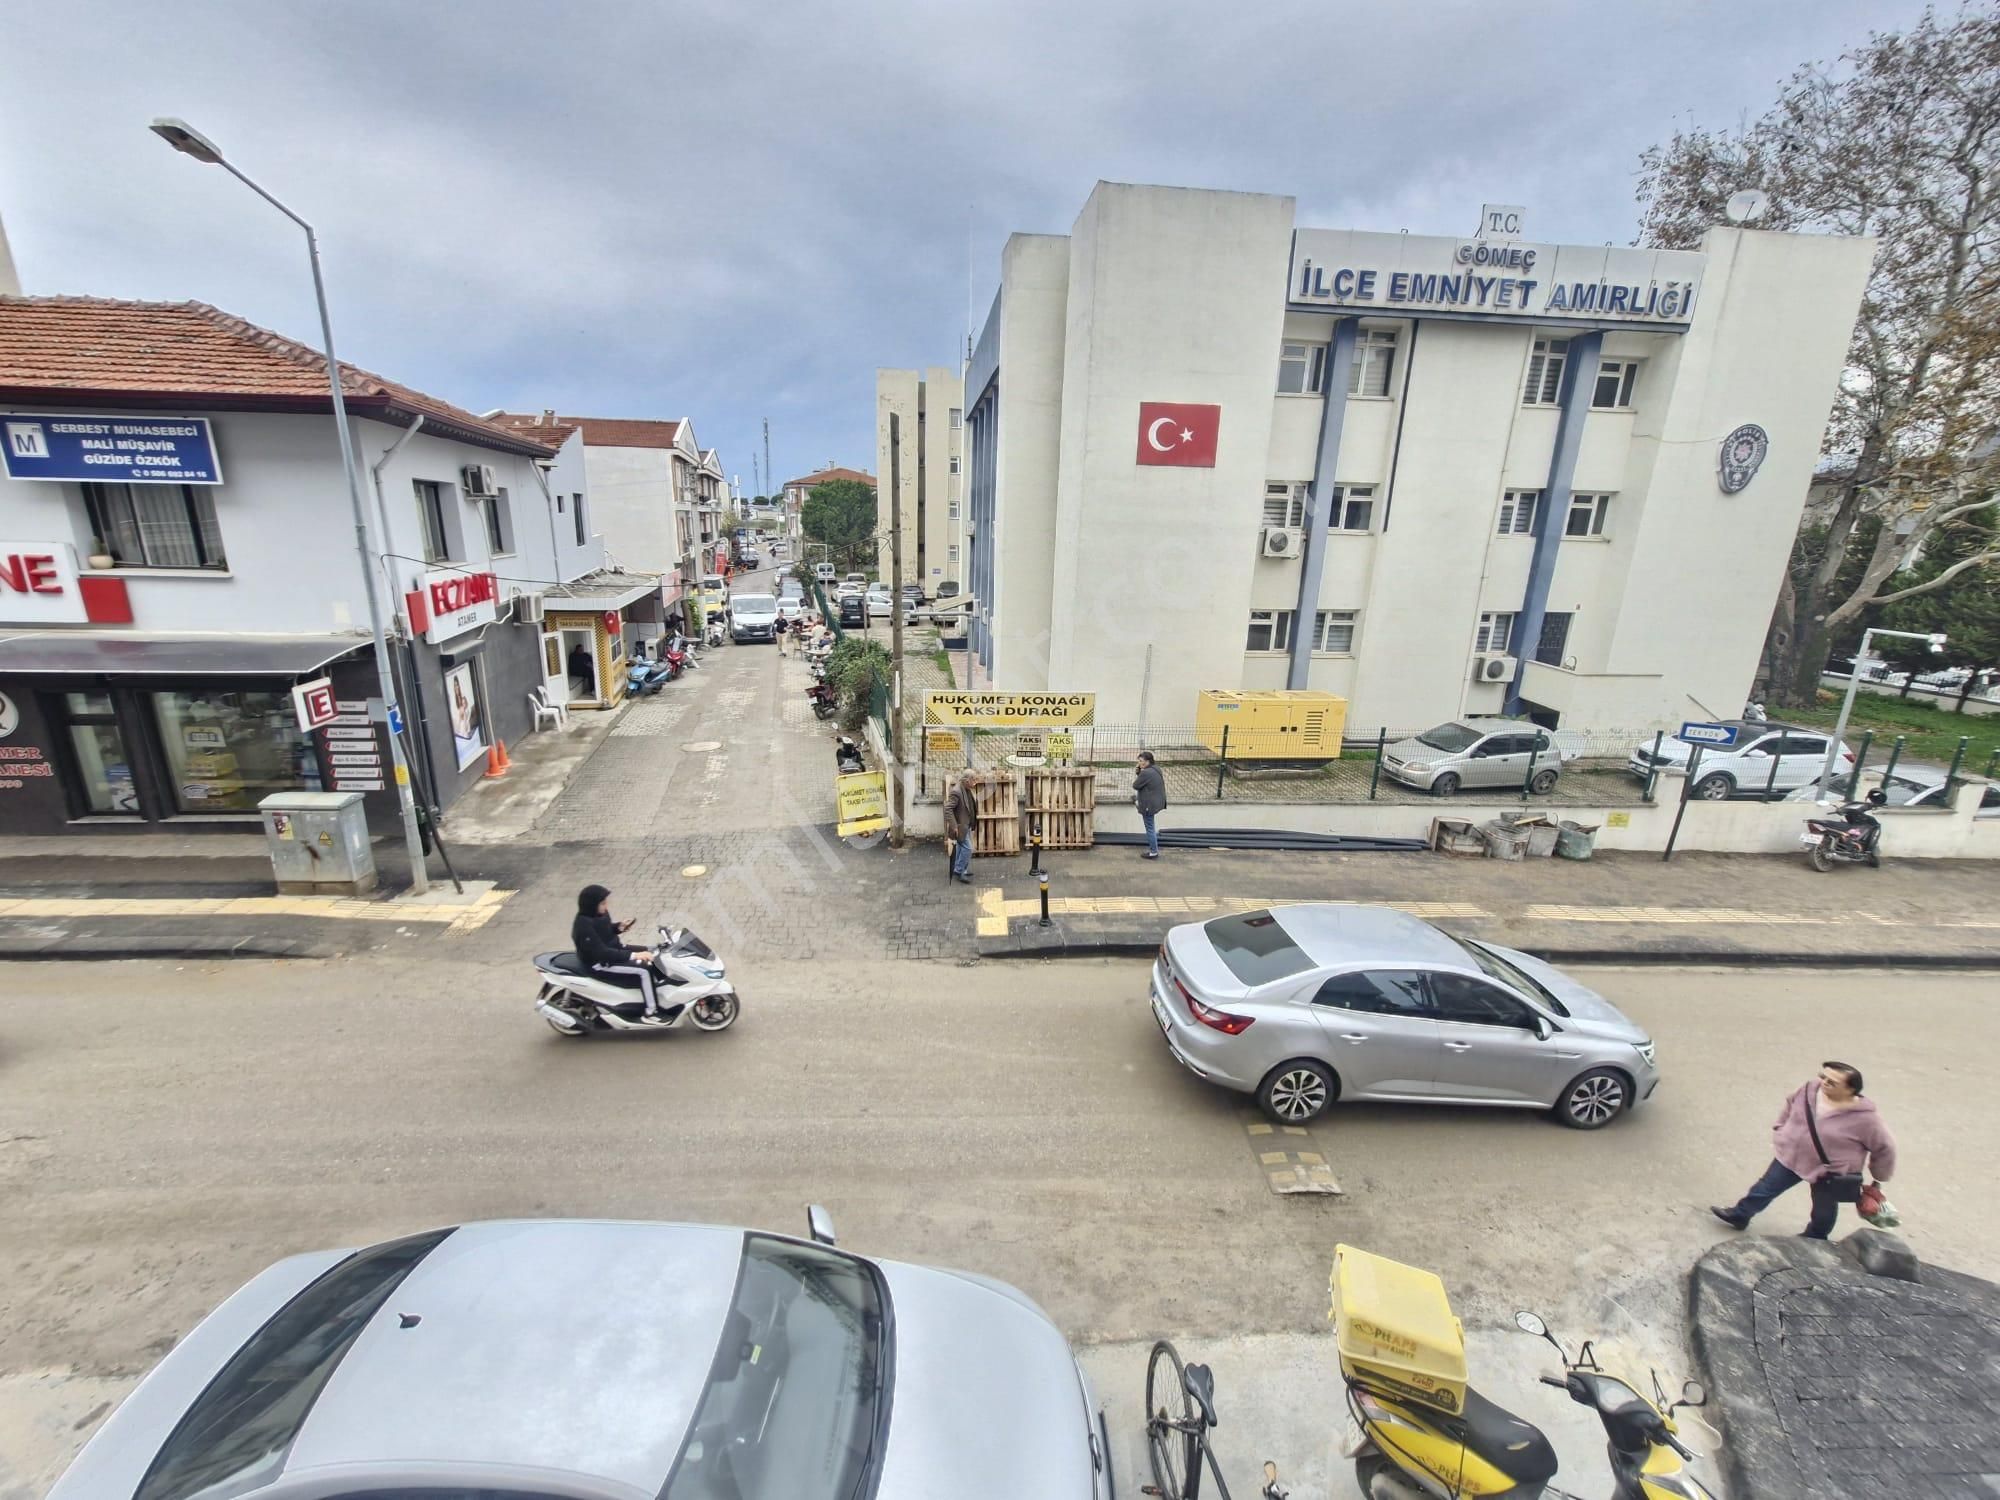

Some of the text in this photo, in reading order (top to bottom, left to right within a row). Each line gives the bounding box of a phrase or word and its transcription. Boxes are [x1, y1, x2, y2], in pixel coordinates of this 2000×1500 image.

[1489, 212, 1520, 234] T.C.
[1456, 242, 1537, 274] GÖMEÇ
[1301, 258, 1377, 304] İLÇE
[1389, 268, 1537, 309] EMNİYET
[51, 423, 109, 435] SERBEST
[114, 425, 198, 437] MUHASEBECİ
[82, 438, 176, 453] MALİ MÜŞAVİR
[83, 453, 181, 467] GÜZİDE ÖZKÖK
[314, 692, 331, 717] E
[932, 695, 1086, 706] HÜKÜMET KONAĞI
[1005, 706, 1068, 717] DURAĞI
